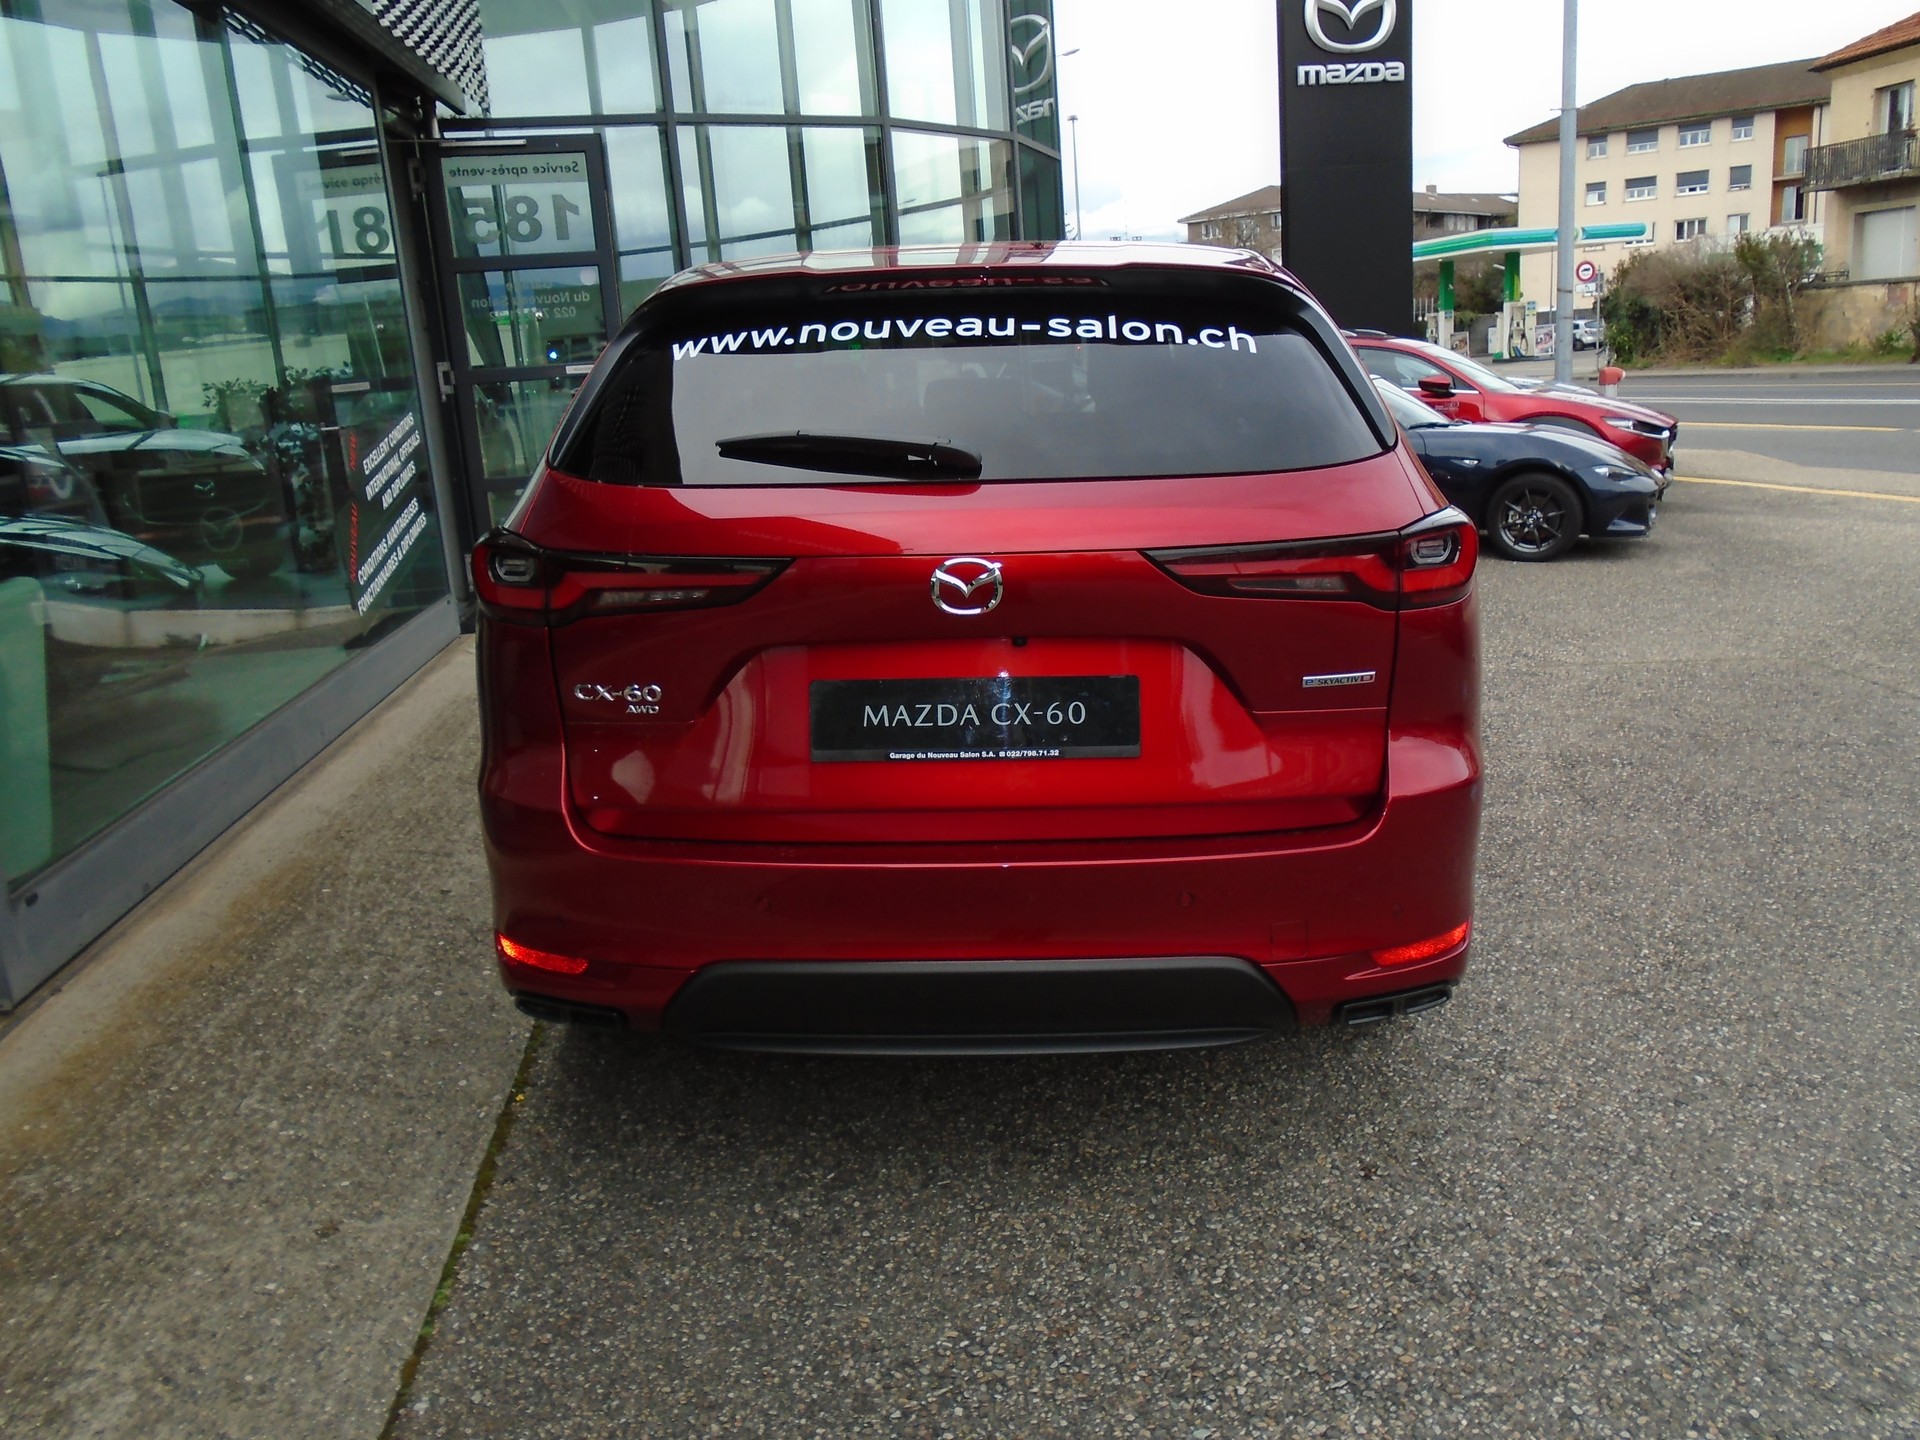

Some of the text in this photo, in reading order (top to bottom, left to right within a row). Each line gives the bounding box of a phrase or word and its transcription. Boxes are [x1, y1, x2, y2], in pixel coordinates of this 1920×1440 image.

[672, 314, 1258, 361] www.nouveau-salon.ch
[362, 436, 391, 476] EXCELLENT
[357, 538, 389, 586] CONDITIONS
[574, 684, 662, 702] CX-60
[626, 704, 660, 714] AWD
[863, 701, 1087, 727] MAZDA CX-60
[889, 752, 915, 760] Garage
[916, 751, 926, 759] du
[927, 751, 959, 759] Nouveau
